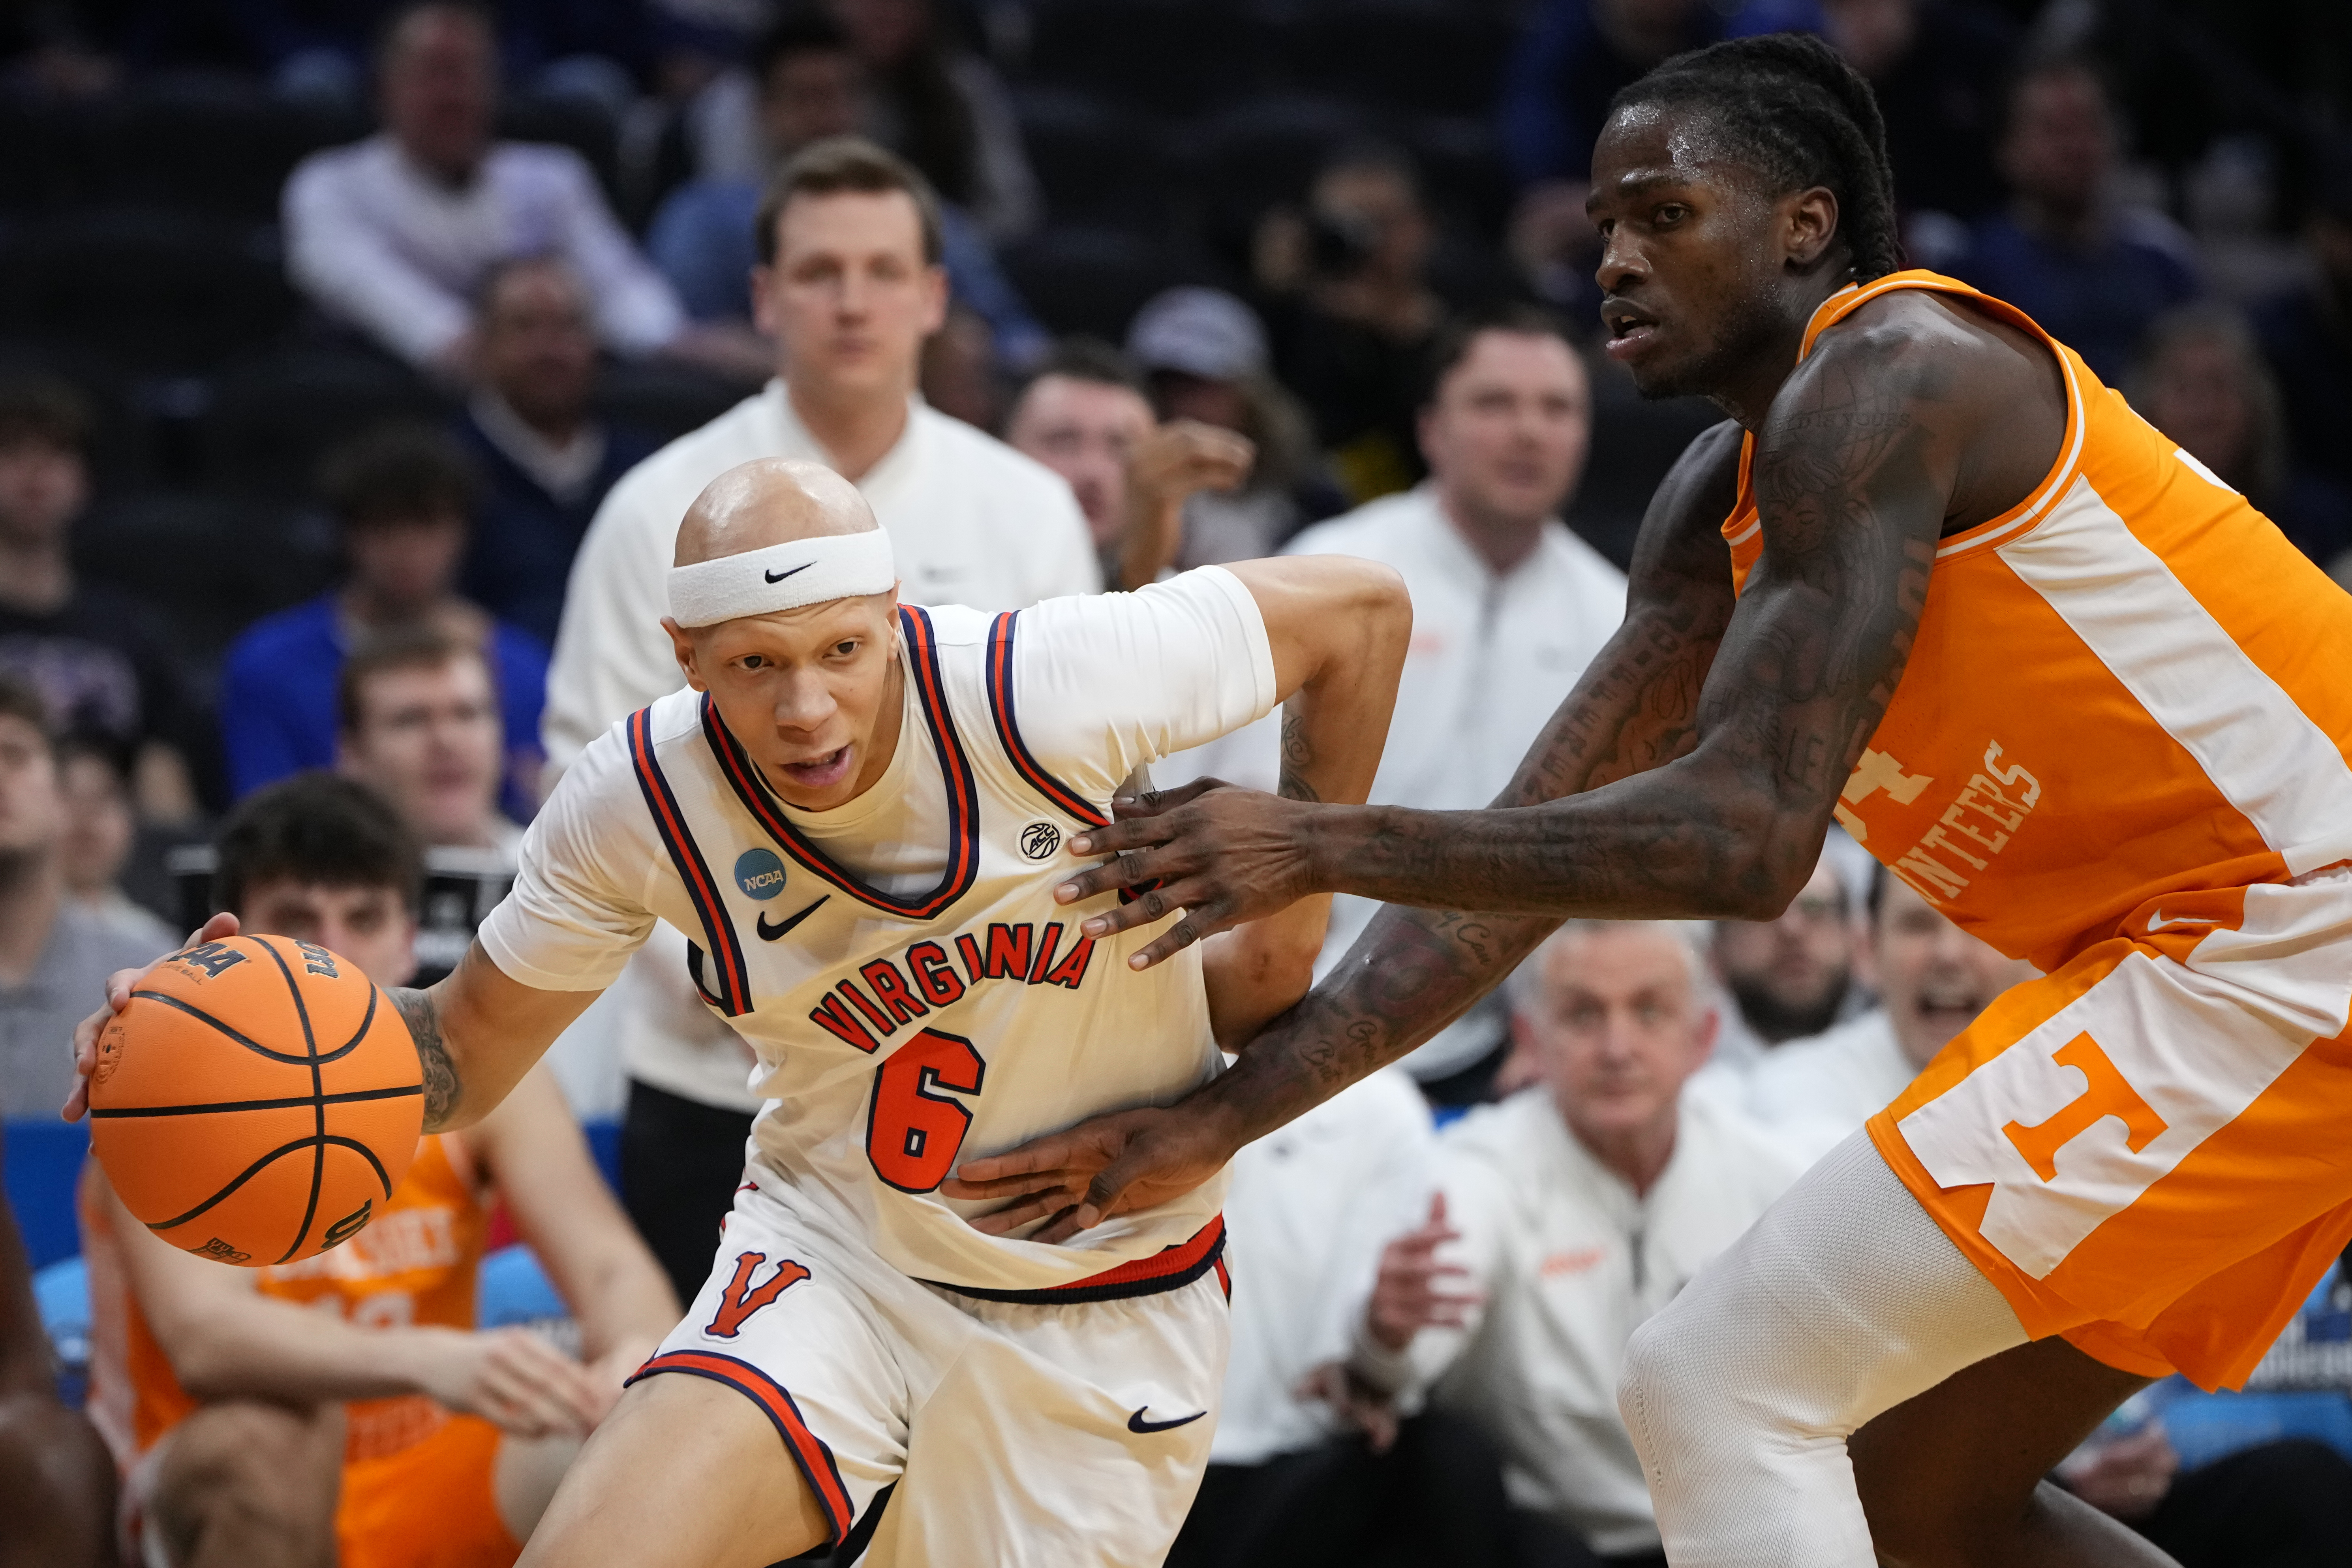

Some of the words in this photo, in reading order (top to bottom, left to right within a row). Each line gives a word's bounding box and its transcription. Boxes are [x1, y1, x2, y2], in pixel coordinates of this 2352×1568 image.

[744, 869, 784, 891] NCAA
[1029, 826, 1055, 849] ACC
[809, 923, 1096, 1055] VIRGINIA
[866, 1027, 986, 1194] 6
[2001, 1030, 2169, 1183] T
[705, 1251, 811, 1338] V
